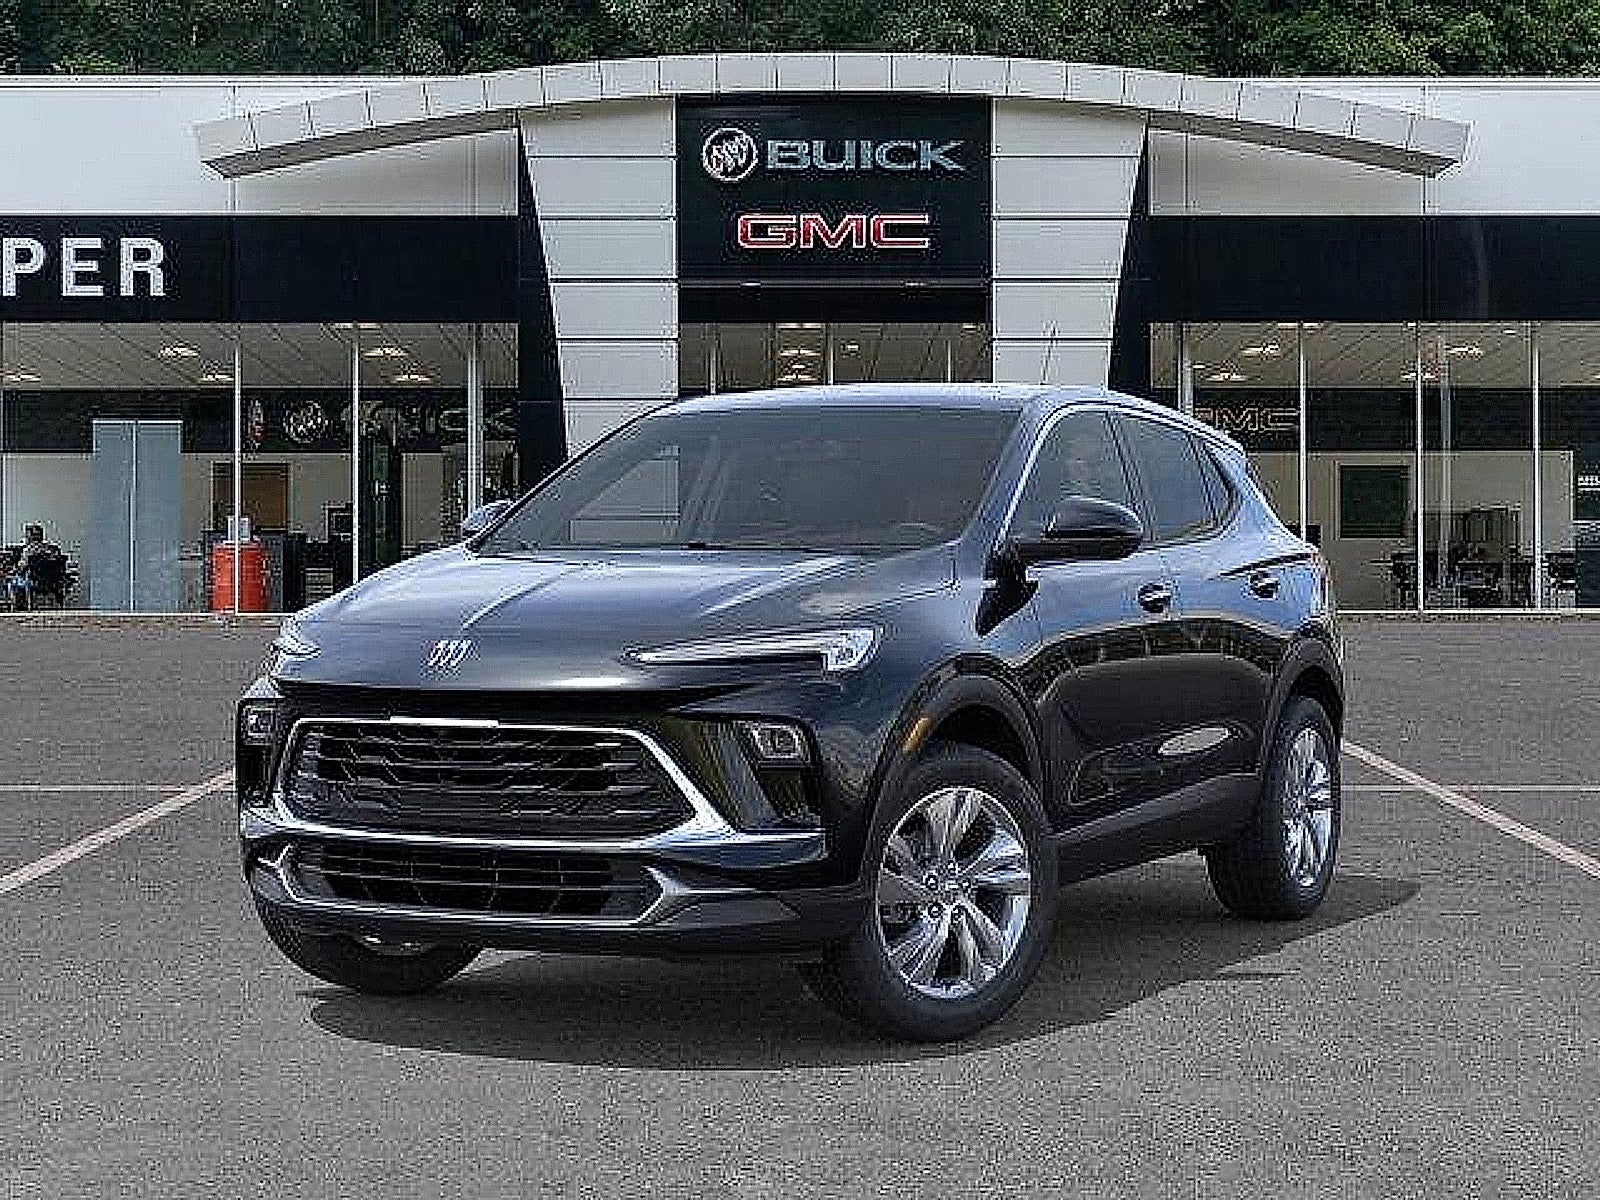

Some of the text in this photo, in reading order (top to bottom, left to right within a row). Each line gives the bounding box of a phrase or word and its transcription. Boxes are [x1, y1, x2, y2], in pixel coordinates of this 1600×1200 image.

[767, 139, 965, 171] BUICK
[737, 214, 929, 248] GMC
[2, 237, 165, 297] PER
